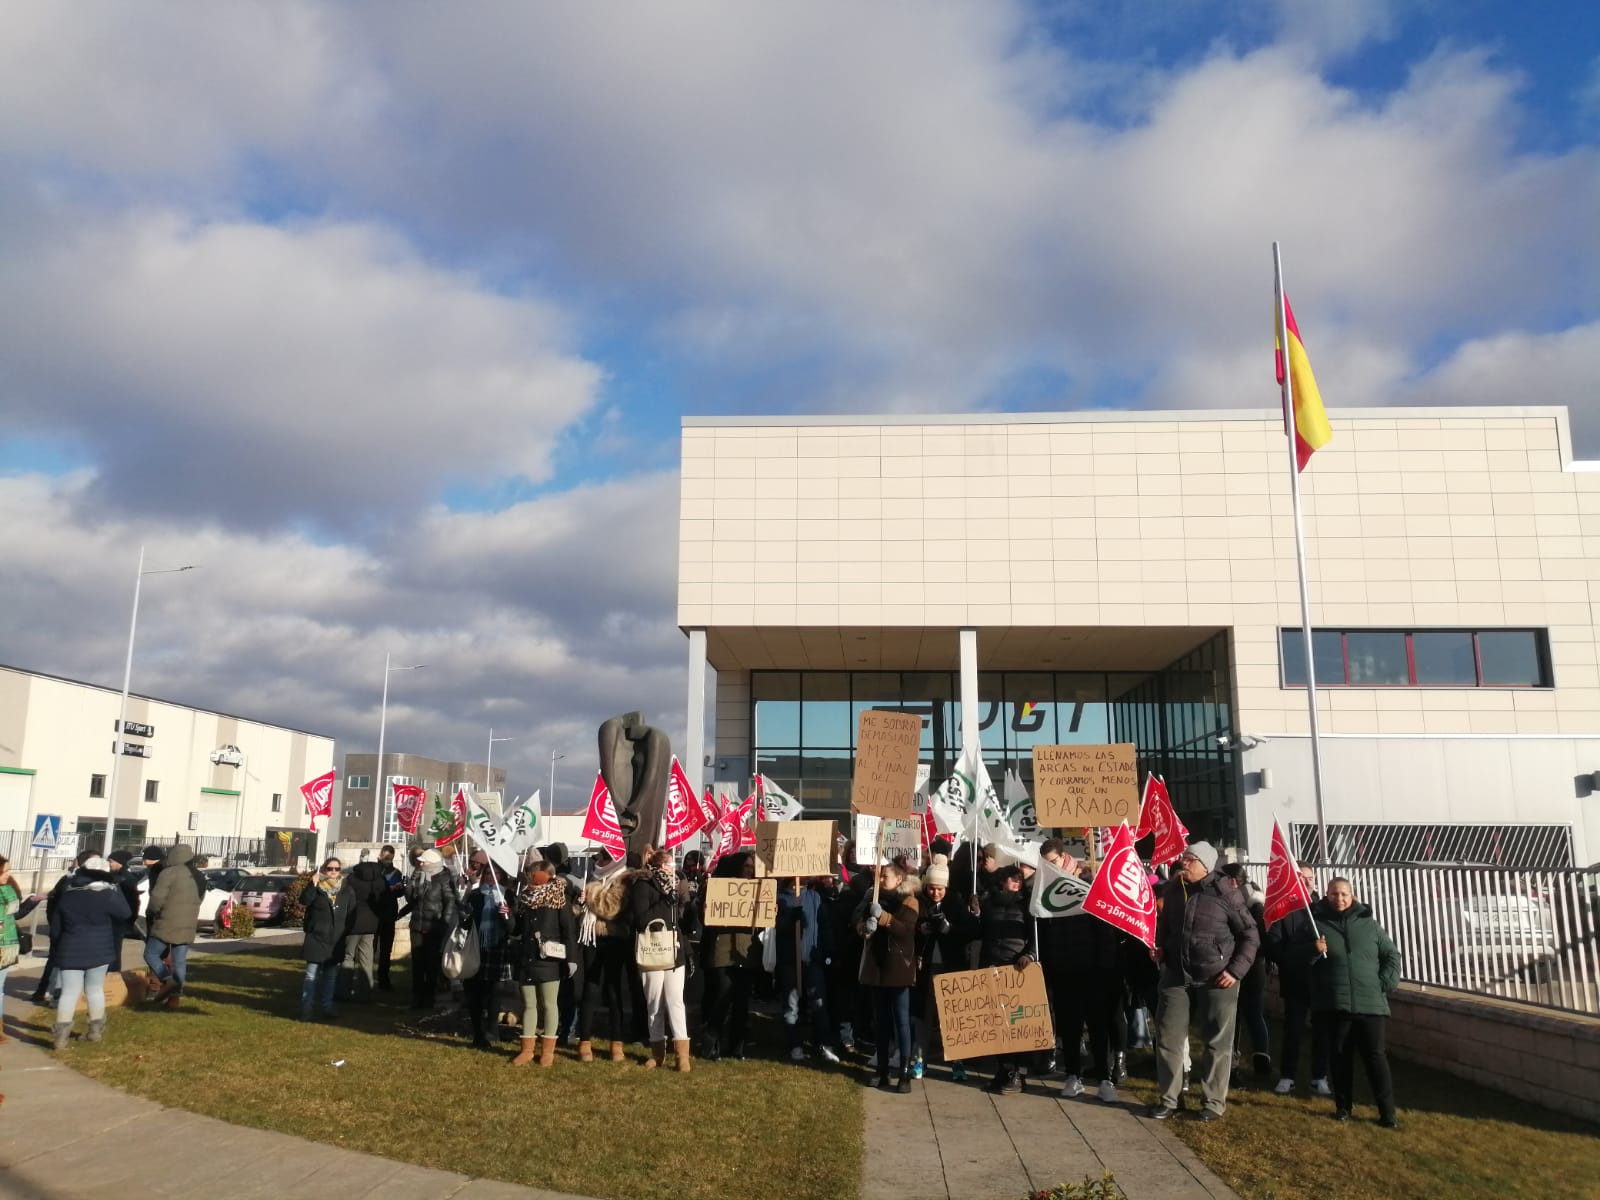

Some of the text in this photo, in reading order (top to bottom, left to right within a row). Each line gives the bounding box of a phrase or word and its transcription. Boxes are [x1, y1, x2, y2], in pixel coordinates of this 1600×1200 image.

[863, 717, 917, 730] ME SOBRA
[861, 729, 917, 746] DEMASIADO
[867, 743, 903, 759] MES
[1037, 750, 1115, 761] LLENAMOS LAS
[877, 762, 909, 775] FINAL
[1039, 763, 1077, 773] ARCAS
[871, 772, 895, 784] DEL
[1039, 777, 1046, 787] Y
[1102, 775, 1137, 785] MENOS
[856, 786, 911, 810] SUELDO
[1067, 786, 1087, 796] QUE
[1046, 796, 1129, 818] PARADO
[727, 881, 760, 899] DGT
[1096, 899, 1150, 934] www.ugt.es
[940, 973, 987, 997] RADAR
[944, 993, 1020, 1016] RECAUDANDO
[945, 1012, 1004, 1032] NUESTROS
